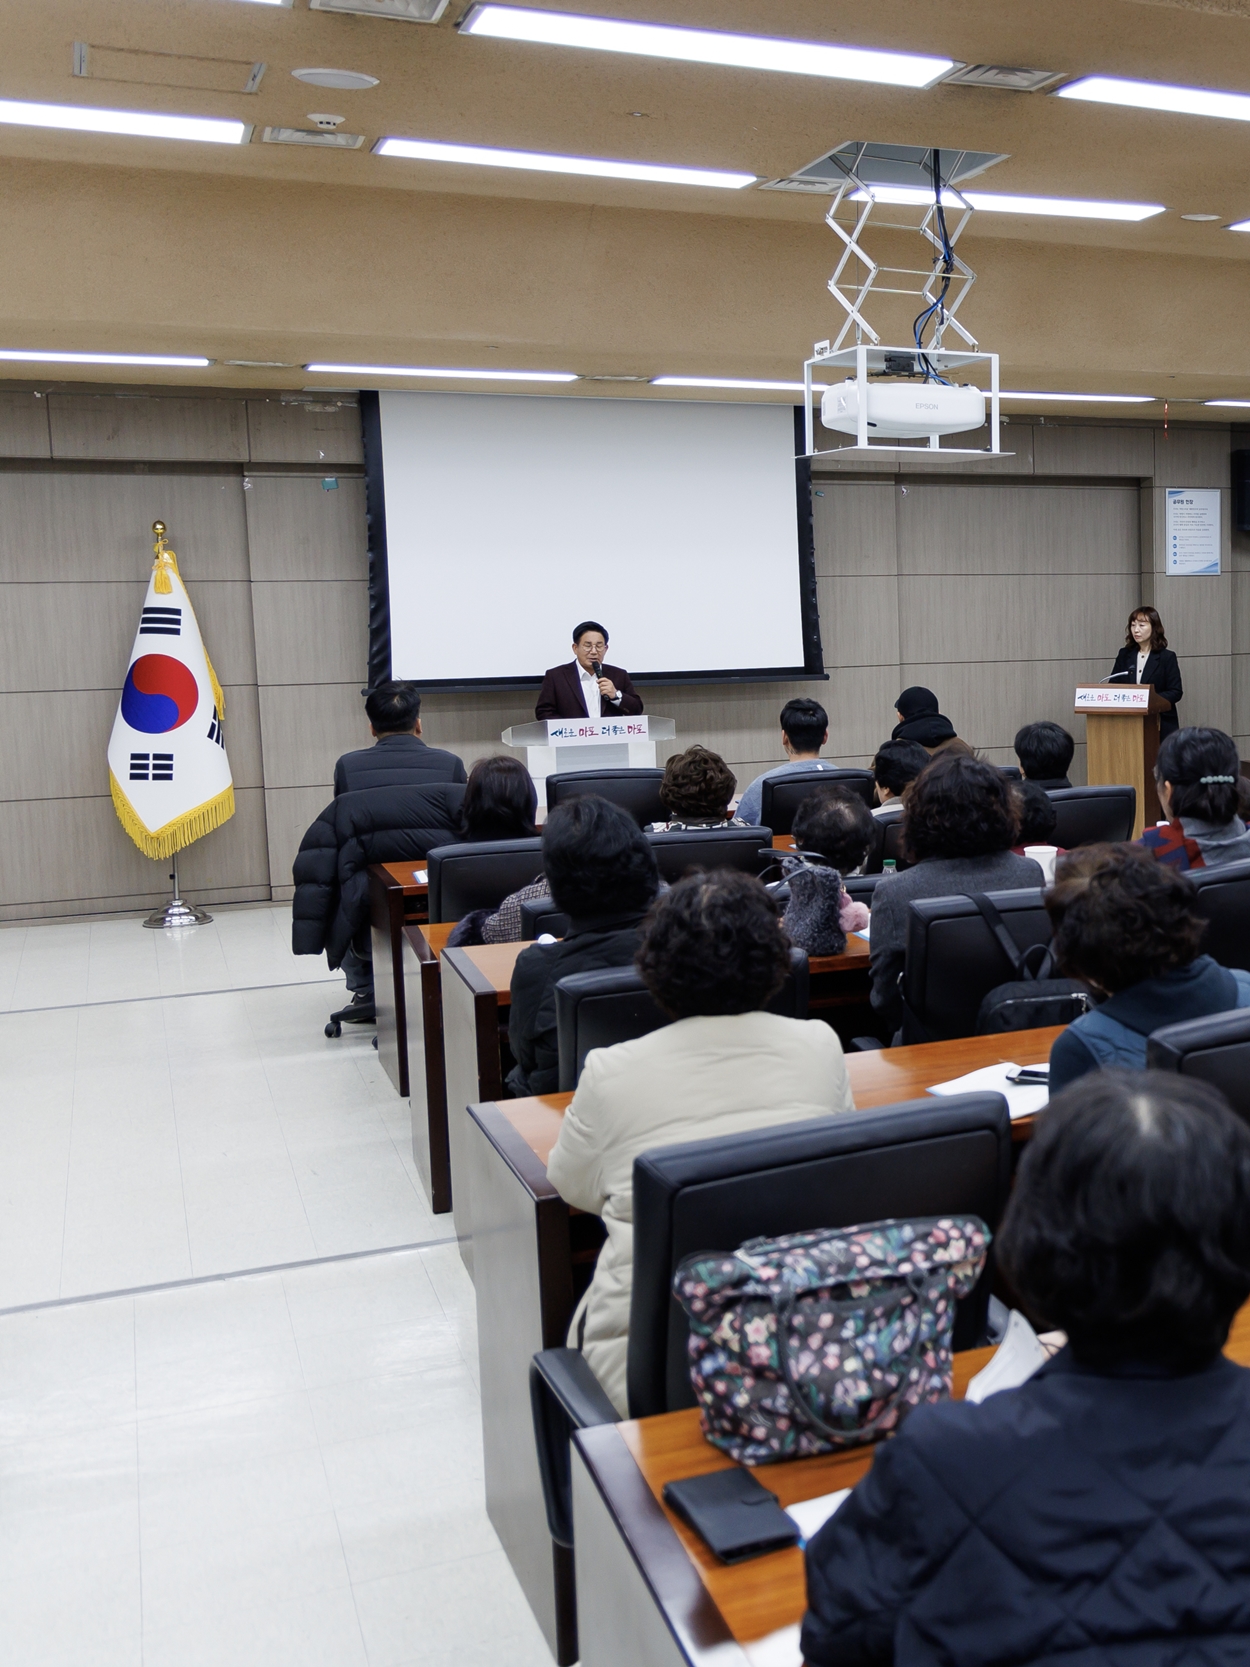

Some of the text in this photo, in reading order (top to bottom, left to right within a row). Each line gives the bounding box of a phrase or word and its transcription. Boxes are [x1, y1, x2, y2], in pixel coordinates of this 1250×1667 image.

[915, 402, 939, 410] EPSON
[550, 727, 577, 738] 새로운
[578, 726, 599, 737] 마포
[601, 725, 611, 736] 더
[627, 724, 646, 735] 마포
